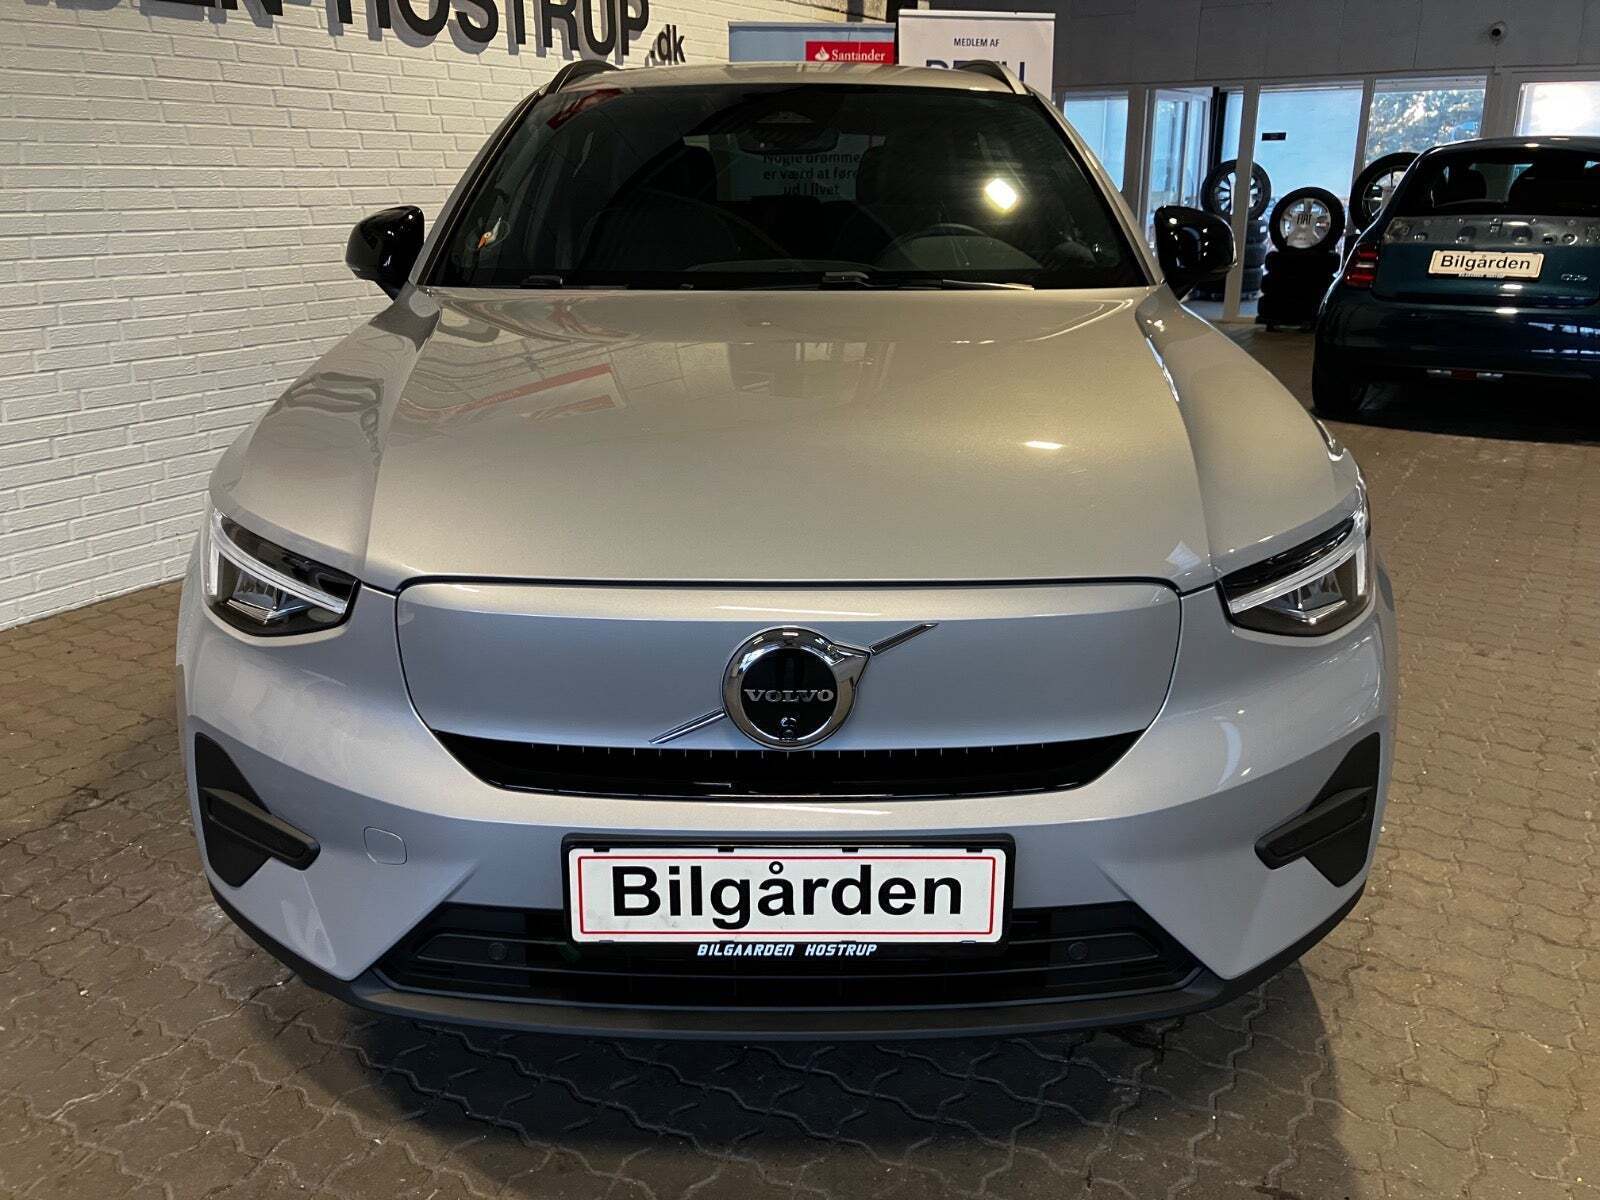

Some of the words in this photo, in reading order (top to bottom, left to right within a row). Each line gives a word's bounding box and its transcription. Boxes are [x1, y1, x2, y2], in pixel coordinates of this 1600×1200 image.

[953, 37, 988, 48] MEDLEM
[989, 38, 1000, 48] AF
[831, 49, 886, 62] Santander
[1440, 254, 1531, 271] Bilgården
[744, 689, 835, 702] VOLVO
[611, 861, 962, 930] Bilgården
[697, 943, 795, 957] BILGAARDEN
[805, 943, 877, 957] HOSTRUP
